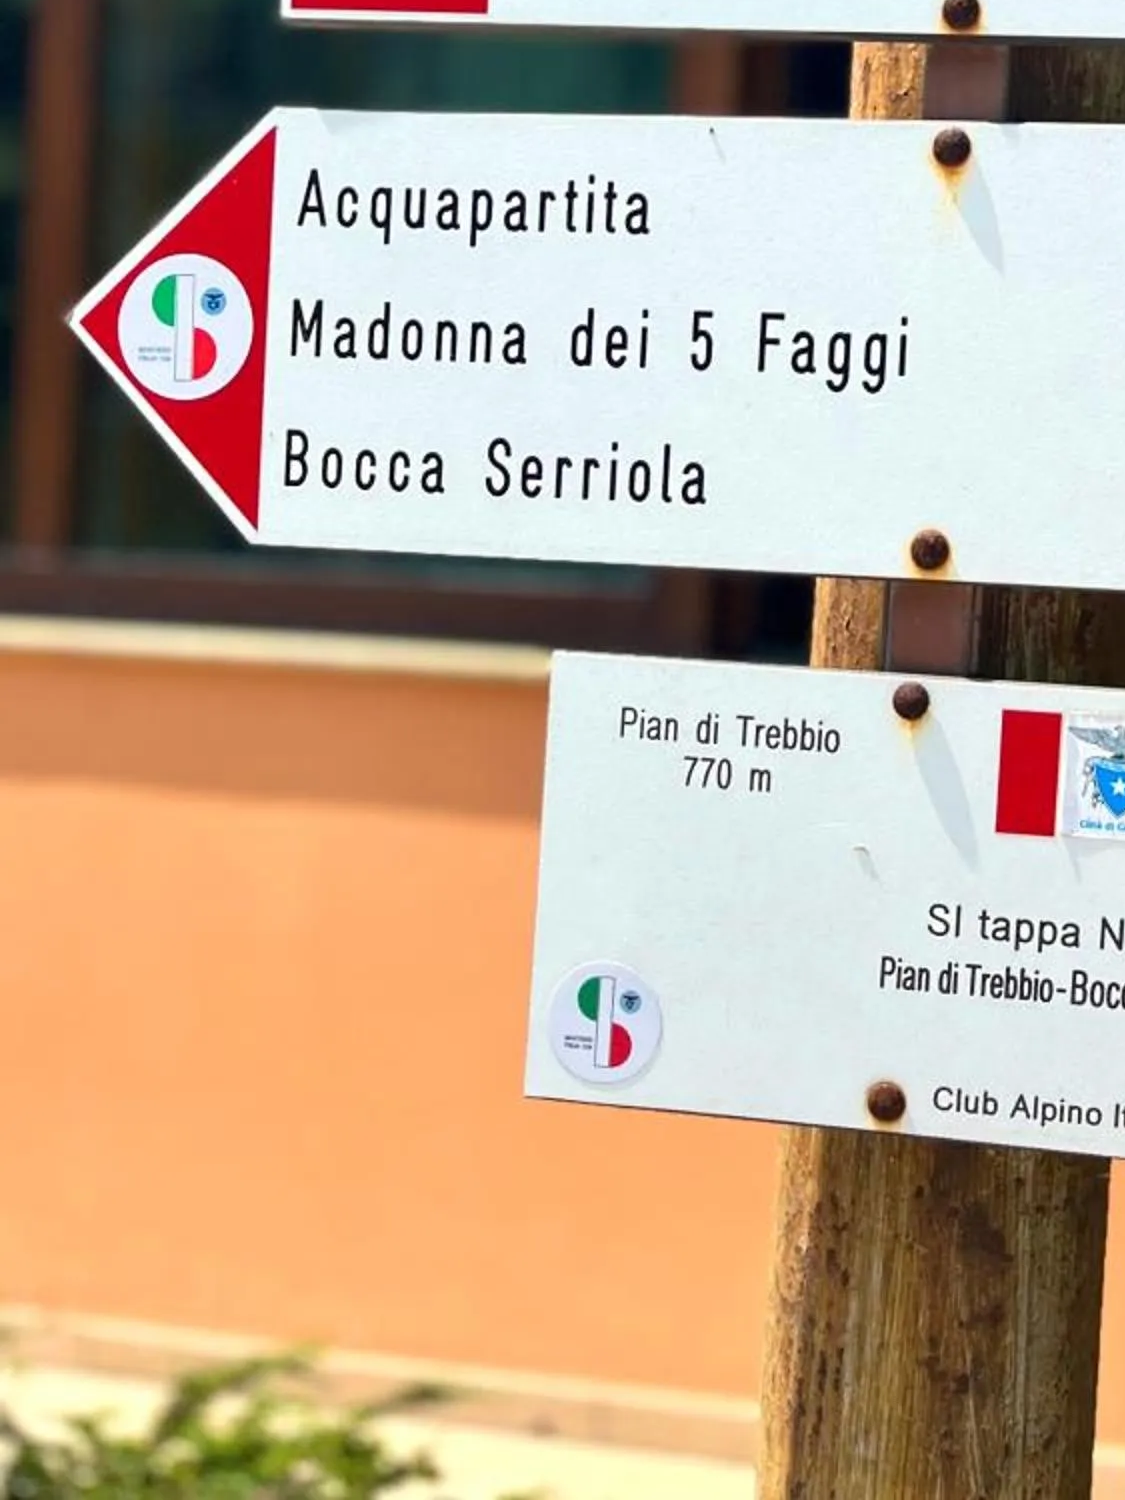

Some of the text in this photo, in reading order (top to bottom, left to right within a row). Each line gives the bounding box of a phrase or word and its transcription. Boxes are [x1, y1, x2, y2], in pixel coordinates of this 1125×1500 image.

[297, 168, 651, 248] Acquapartita
[290, 298, 909, 395] Madonna dei 5 Faggi
[284, 429, 707, 505] Bocca Serriola
[619, 707, 841, 754] Pian di Trebbio
[683, 755, 771, 792] 770 m
[927, 903, 961, 938] SI
[978, 908, 1081, 954] tappa
[1099, 916, 1125, 951] N
[879, 955, 931, 992] Pian
[938, 961, 959, 995] di
[932, 1086, 999, 1116] Club
[1010, 1093, 1103, 1127] Alpino
